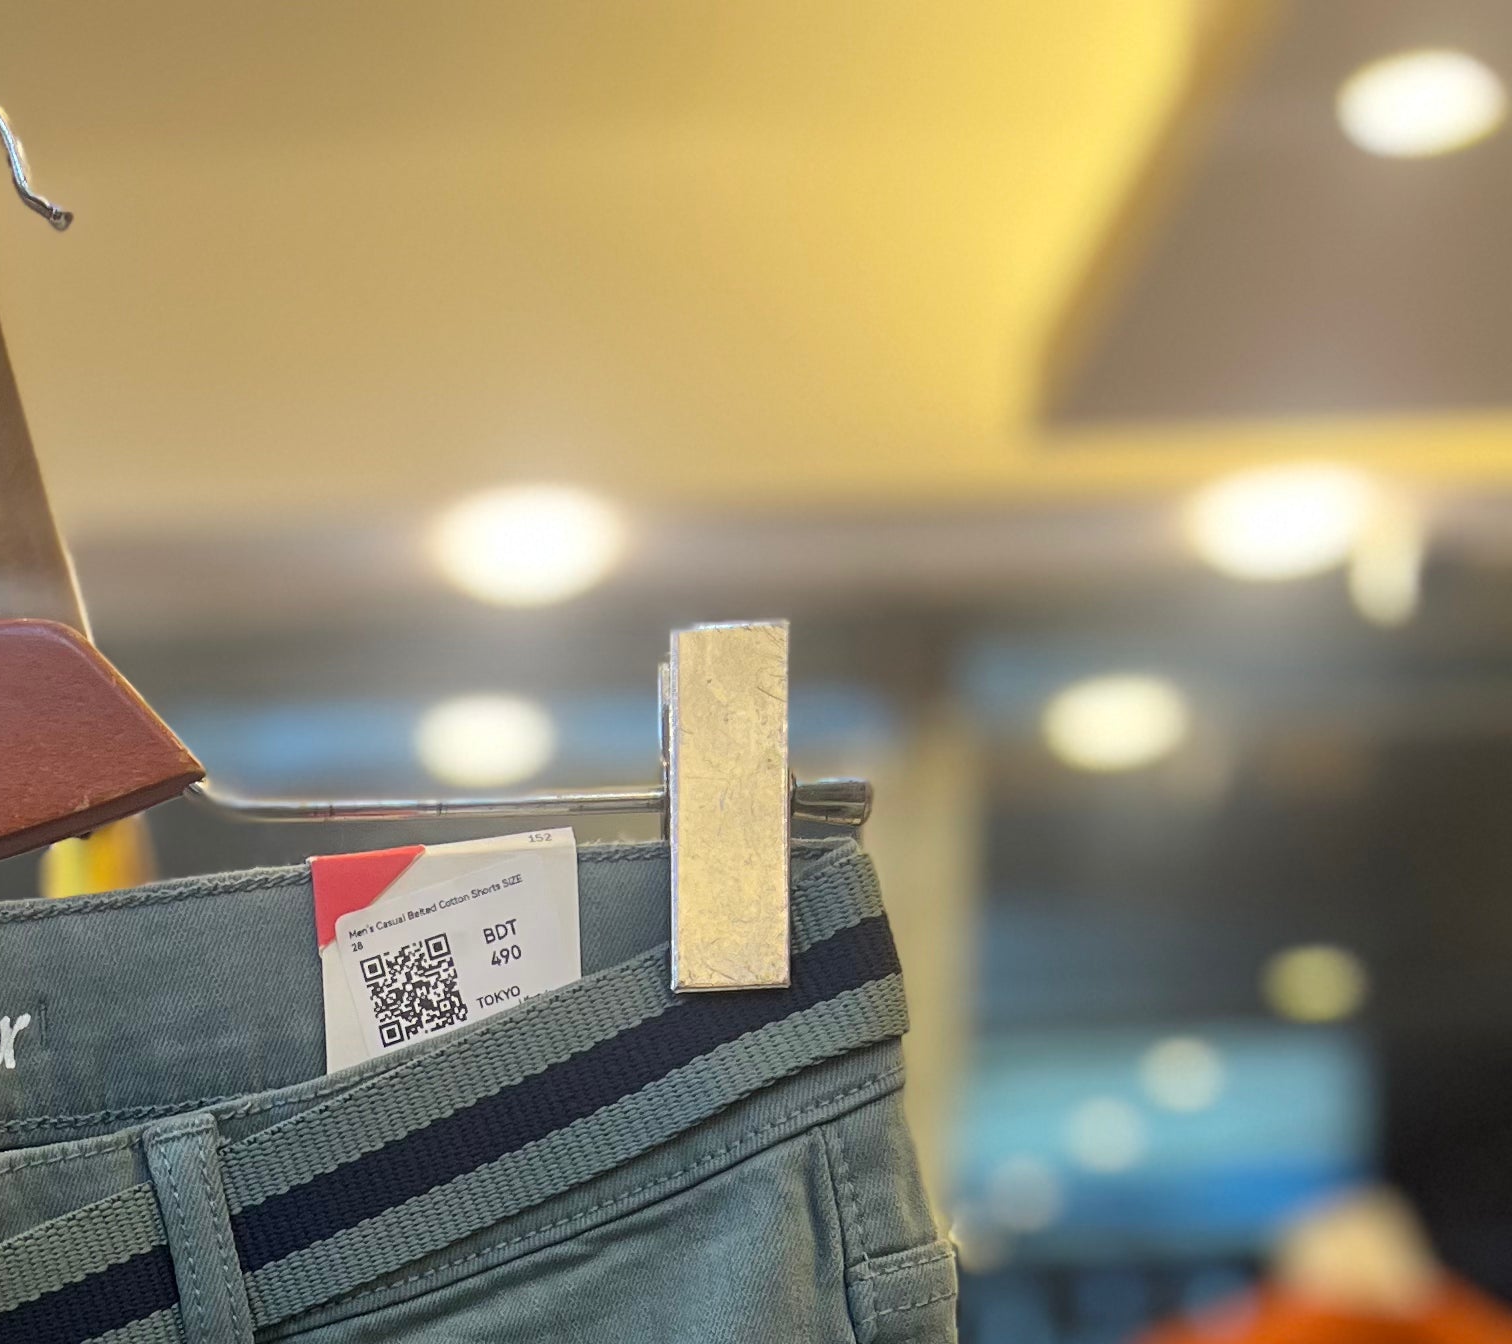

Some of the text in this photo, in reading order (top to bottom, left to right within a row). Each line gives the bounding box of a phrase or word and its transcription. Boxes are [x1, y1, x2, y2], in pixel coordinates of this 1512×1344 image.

[348, 873, 524, 939] Men's Casual Belted Cotton Shorts SIZE
[483, 918, 517, 944] BDT
[351, 941, 364, 952] 28
[491, 944, 522, 966] 490
[476, 985, 521, 1009] TOKYO
